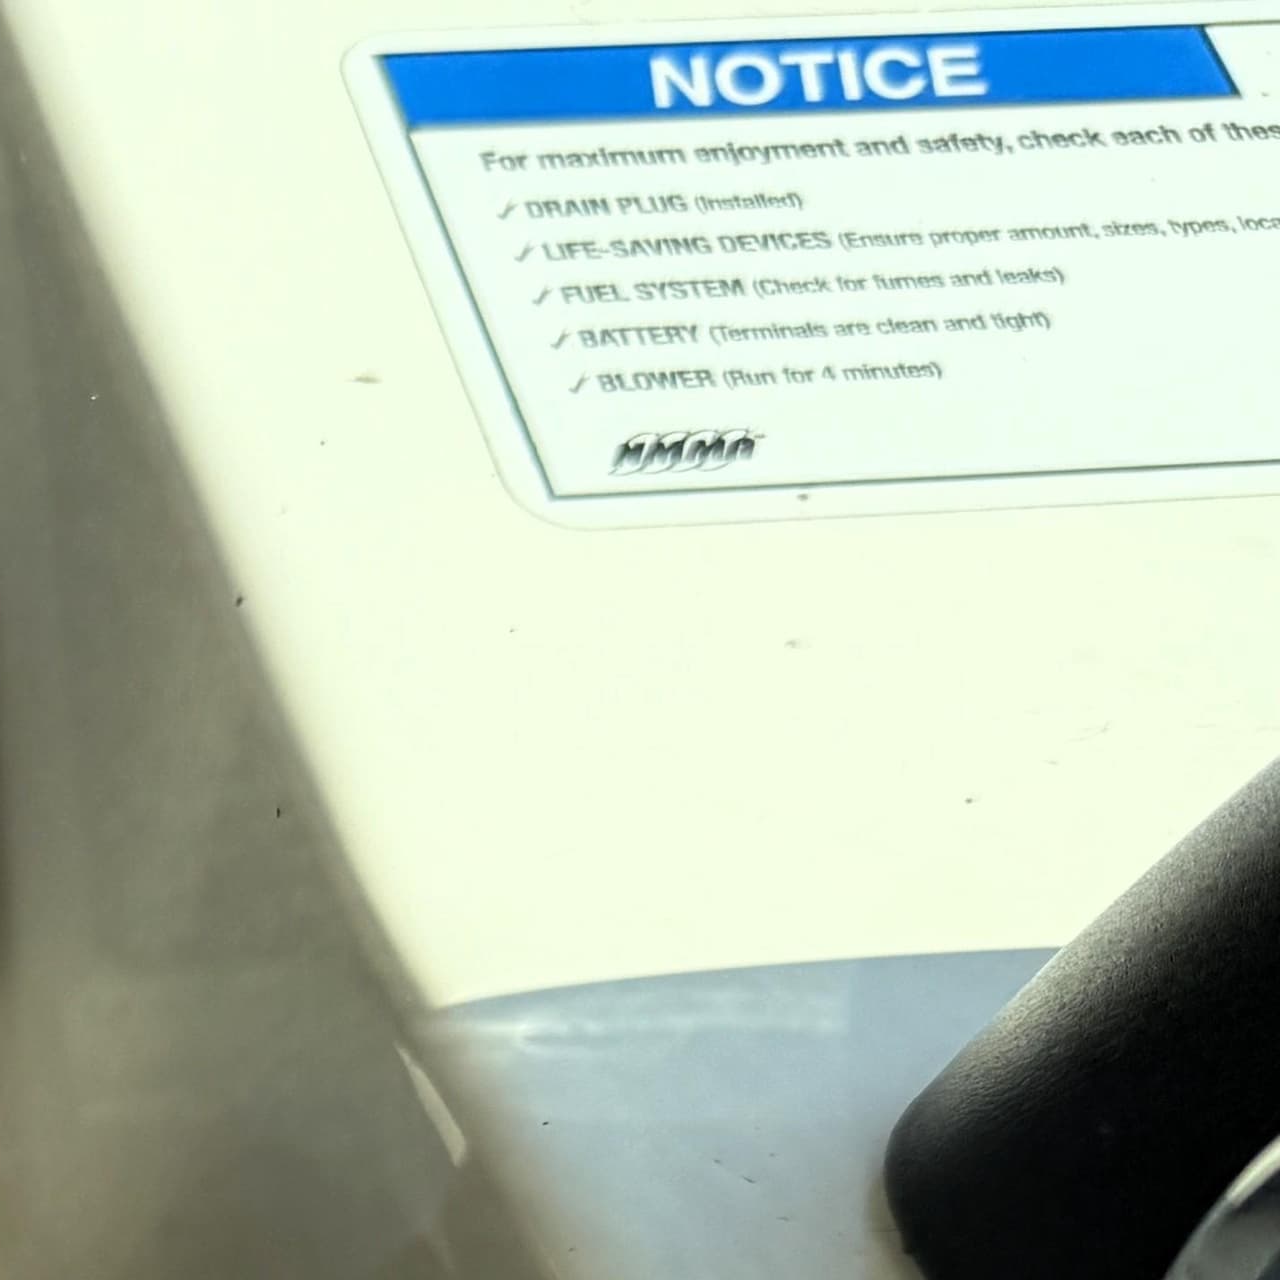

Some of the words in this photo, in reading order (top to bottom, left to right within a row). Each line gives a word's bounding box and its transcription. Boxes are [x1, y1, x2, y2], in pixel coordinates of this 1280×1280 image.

[649, 43, 988, 108] NOTICE
[480, 151, 528, 173] For
[539, 144, 685, 170] maximum
[694, 138, 849, 167] enjoyment
[857, 134, 910, 158] and
[919, 130, 1014, 156] safety,
[1018, 126, 1104, 150] check
[1114, 123, 1182, 146] each
[1188, 122, 1218, 143] of
[525, 198, 610, 219] DRAIN
[618, 194, 688, 215] PLUG
[694, 190, 804, 213] (Installed)
[542, 235, 712, 261] LIFE-SAVING
[720, 231, 832, 254] DEVICES
[839, 230, 923, 253] (Ensure
[930, 227, 999, 248] proper
[1007, 222, 1100, 243] amount,
[1103, 218, 1165, 239] sizes,
[1168, 215, 1236, 238] types,
[561, 282, 632, 305] FUEL
[634, 277, 745, 302] SYSTEM
[752, 275, 831, 299] (Check
[837, 273, 866, 293] for
[873, 270, 943, 291] fumes
[949, 267, 993, 288] and
[995, 264, 1067, 287] leaks)
[578, 325, 700, 348] BATTERY
[709, 320, 827, 346] (Terminals
[834, 320, 870, 337] are
[876, 315, 938, 335] clean
[943, 311, 987, 331] and
[991, 308, 1052, 332] tight)
[598, 369, 714, 393] BLOWER
[723, 367, 776, 391] (Run
[782, 365, 814, 385] for
[821, 364, 836, 382] 4
[843, 359, 943, 383] minutes)
